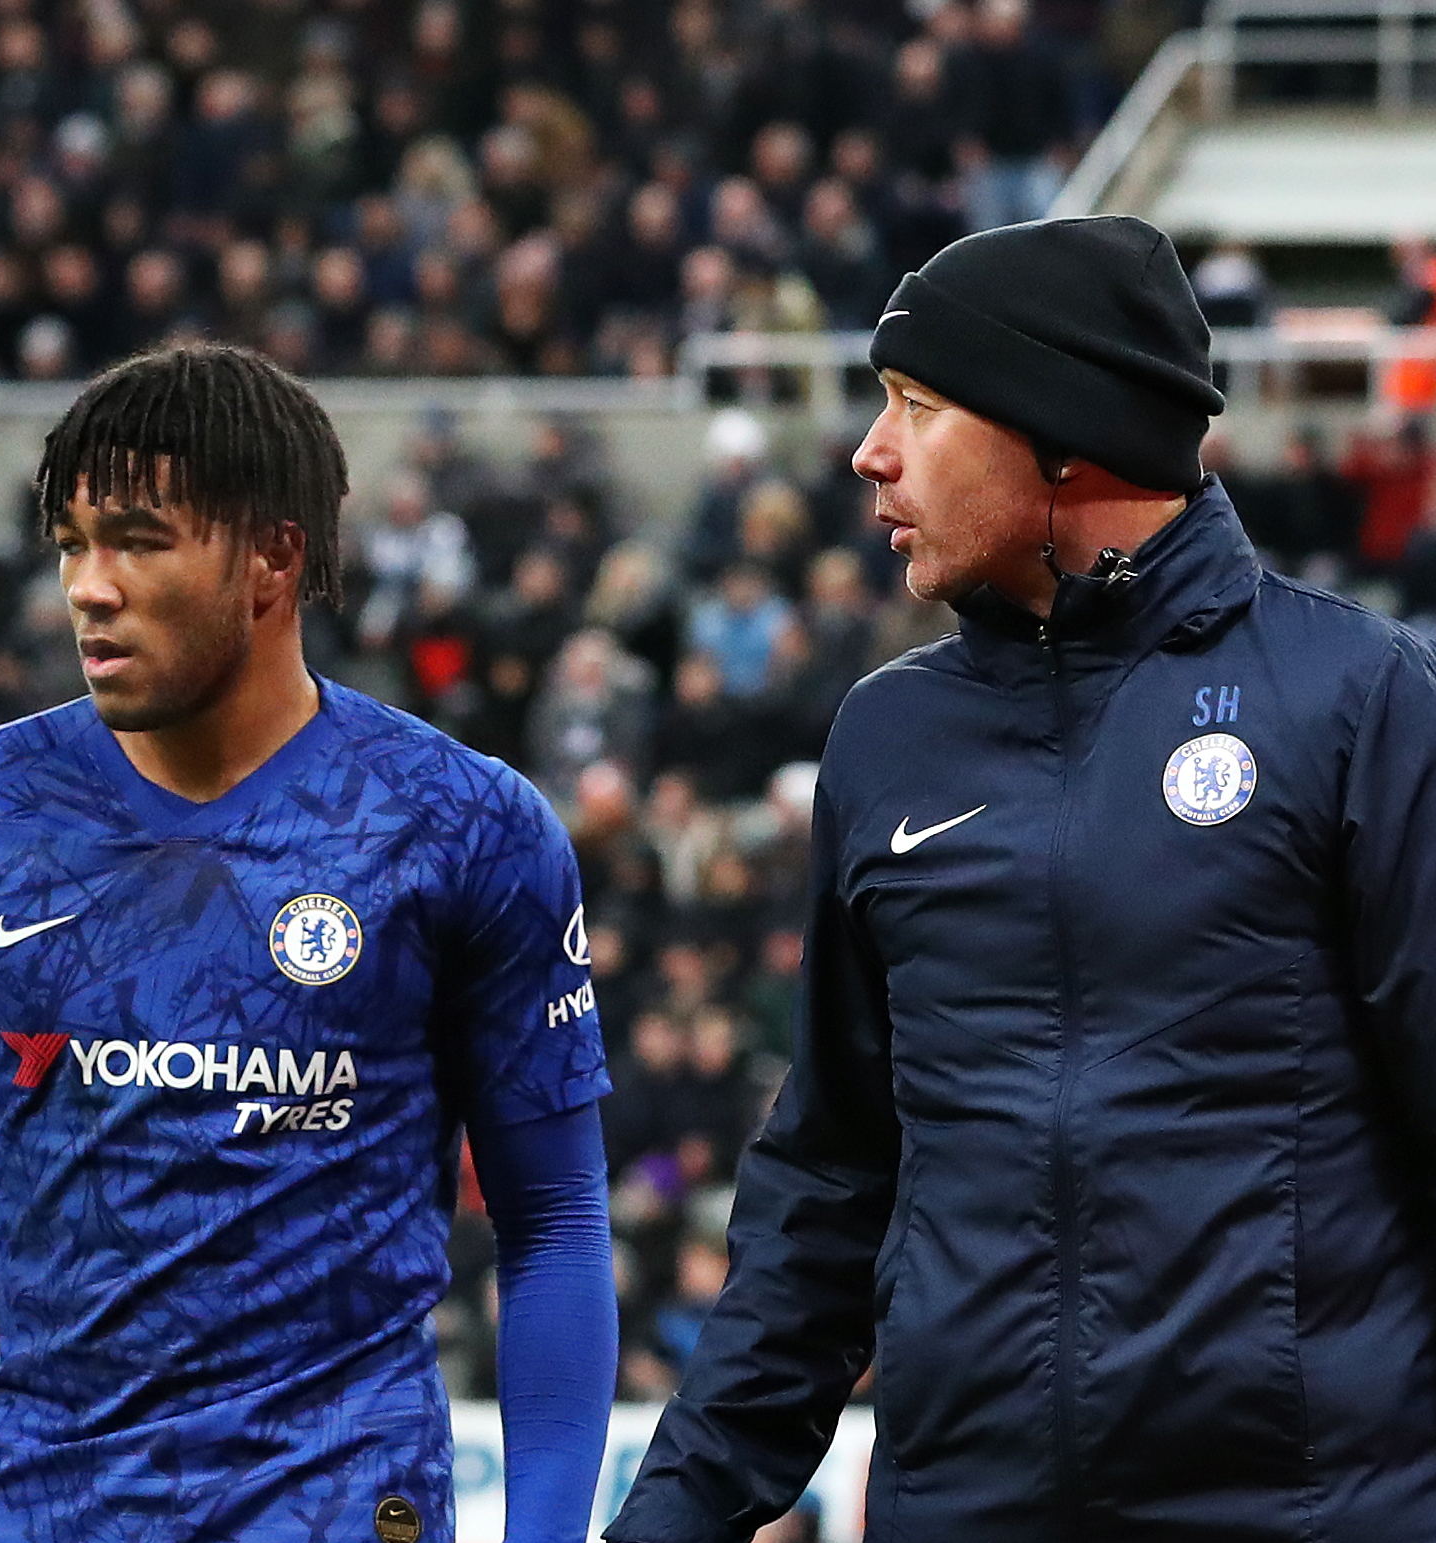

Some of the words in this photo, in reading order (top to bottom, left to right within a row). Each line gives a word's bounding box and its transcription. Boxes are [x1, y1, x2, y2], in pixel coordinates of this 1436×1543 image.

[1192, 685, 1241, 727] SH
[1181, 737, 1240, 758] CHELSEA
[1176, 804, 1217, 821] FOOTBALL
[1219, 801, 1240, 818] CLUB
[288, 898, 347, 920] CHELSEA
[283, 961, 321, 980] FOOTBALL
[323, 964, 344, 979] CLUB
[69, 1039, 358, 1096] YOKOHAMA
[232, 1098, 355, 1134] TYRES
